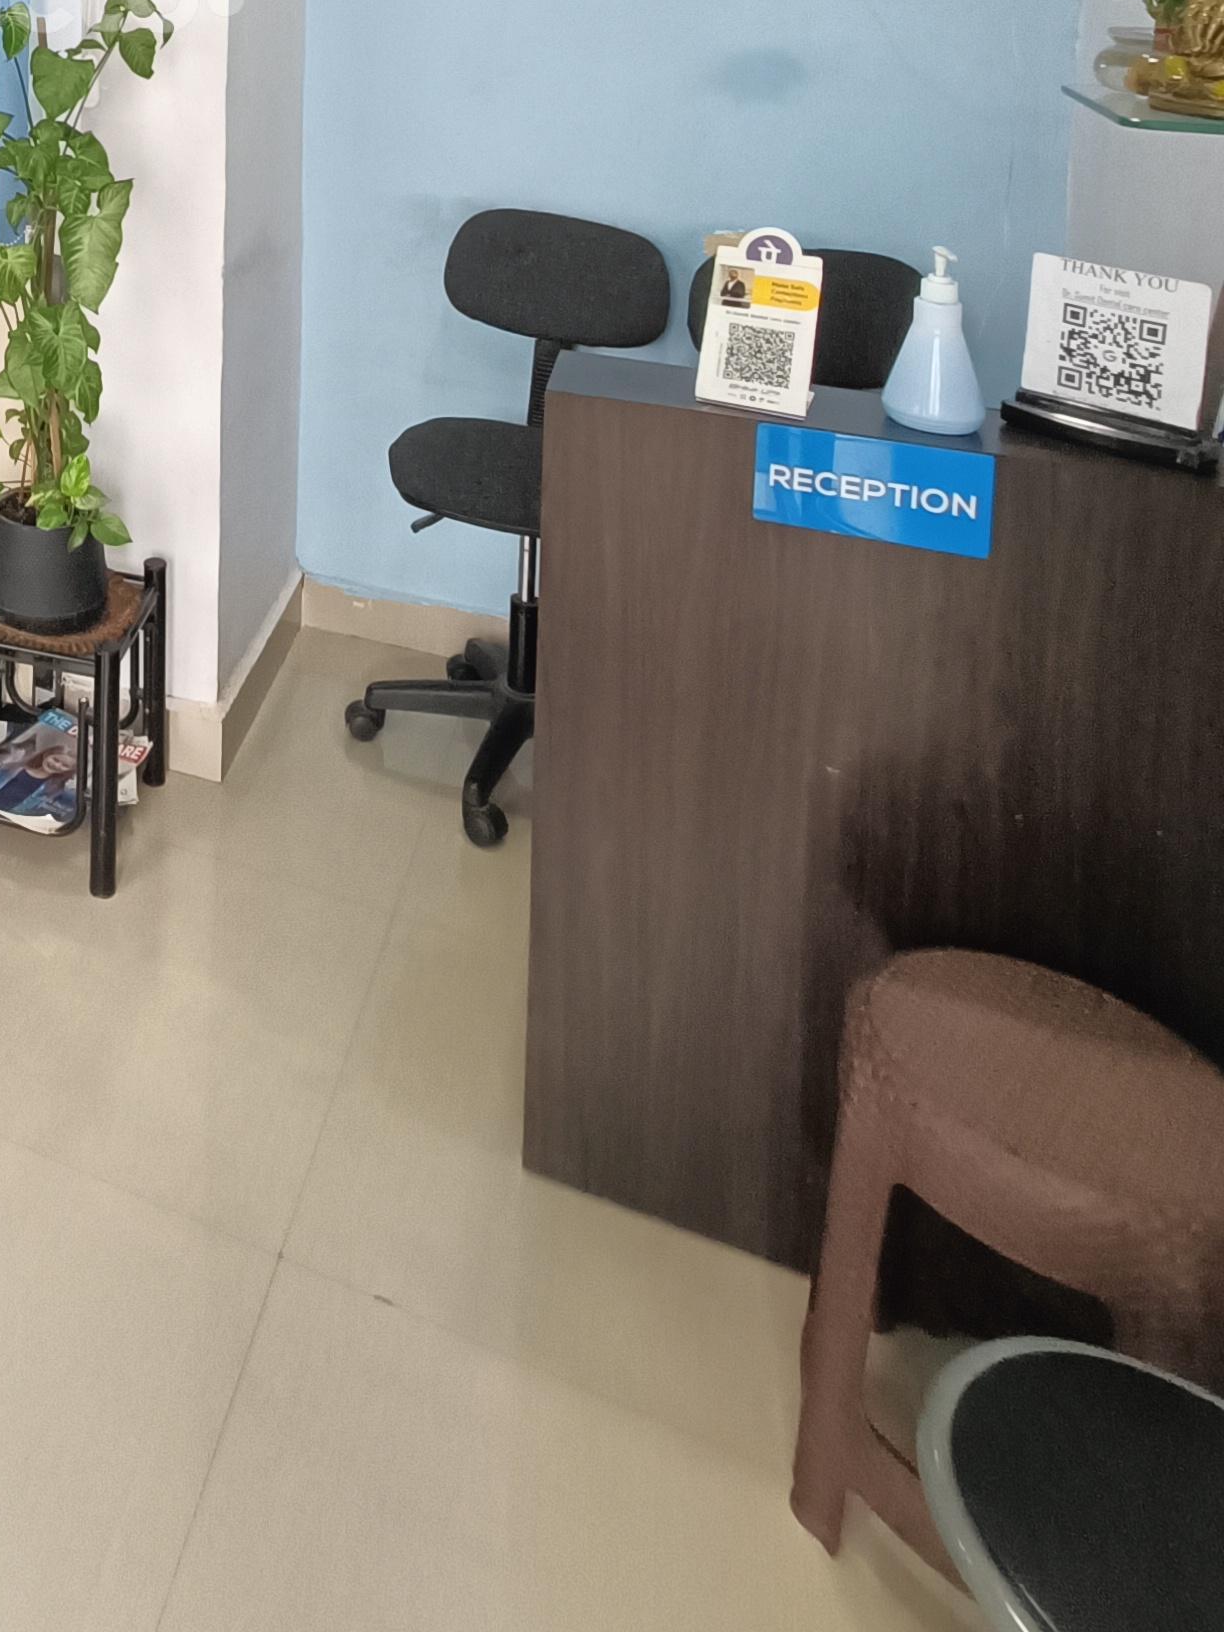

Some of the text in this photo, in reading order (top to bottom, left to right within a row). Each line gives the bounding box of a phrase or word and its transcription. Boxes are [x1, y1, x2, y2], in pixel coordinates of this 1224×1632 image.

[1060, 257, 1180, 293] THANK YOU
[768, 463, 977, 519] RECEPTION
[44, 711, 72, 732] THE
